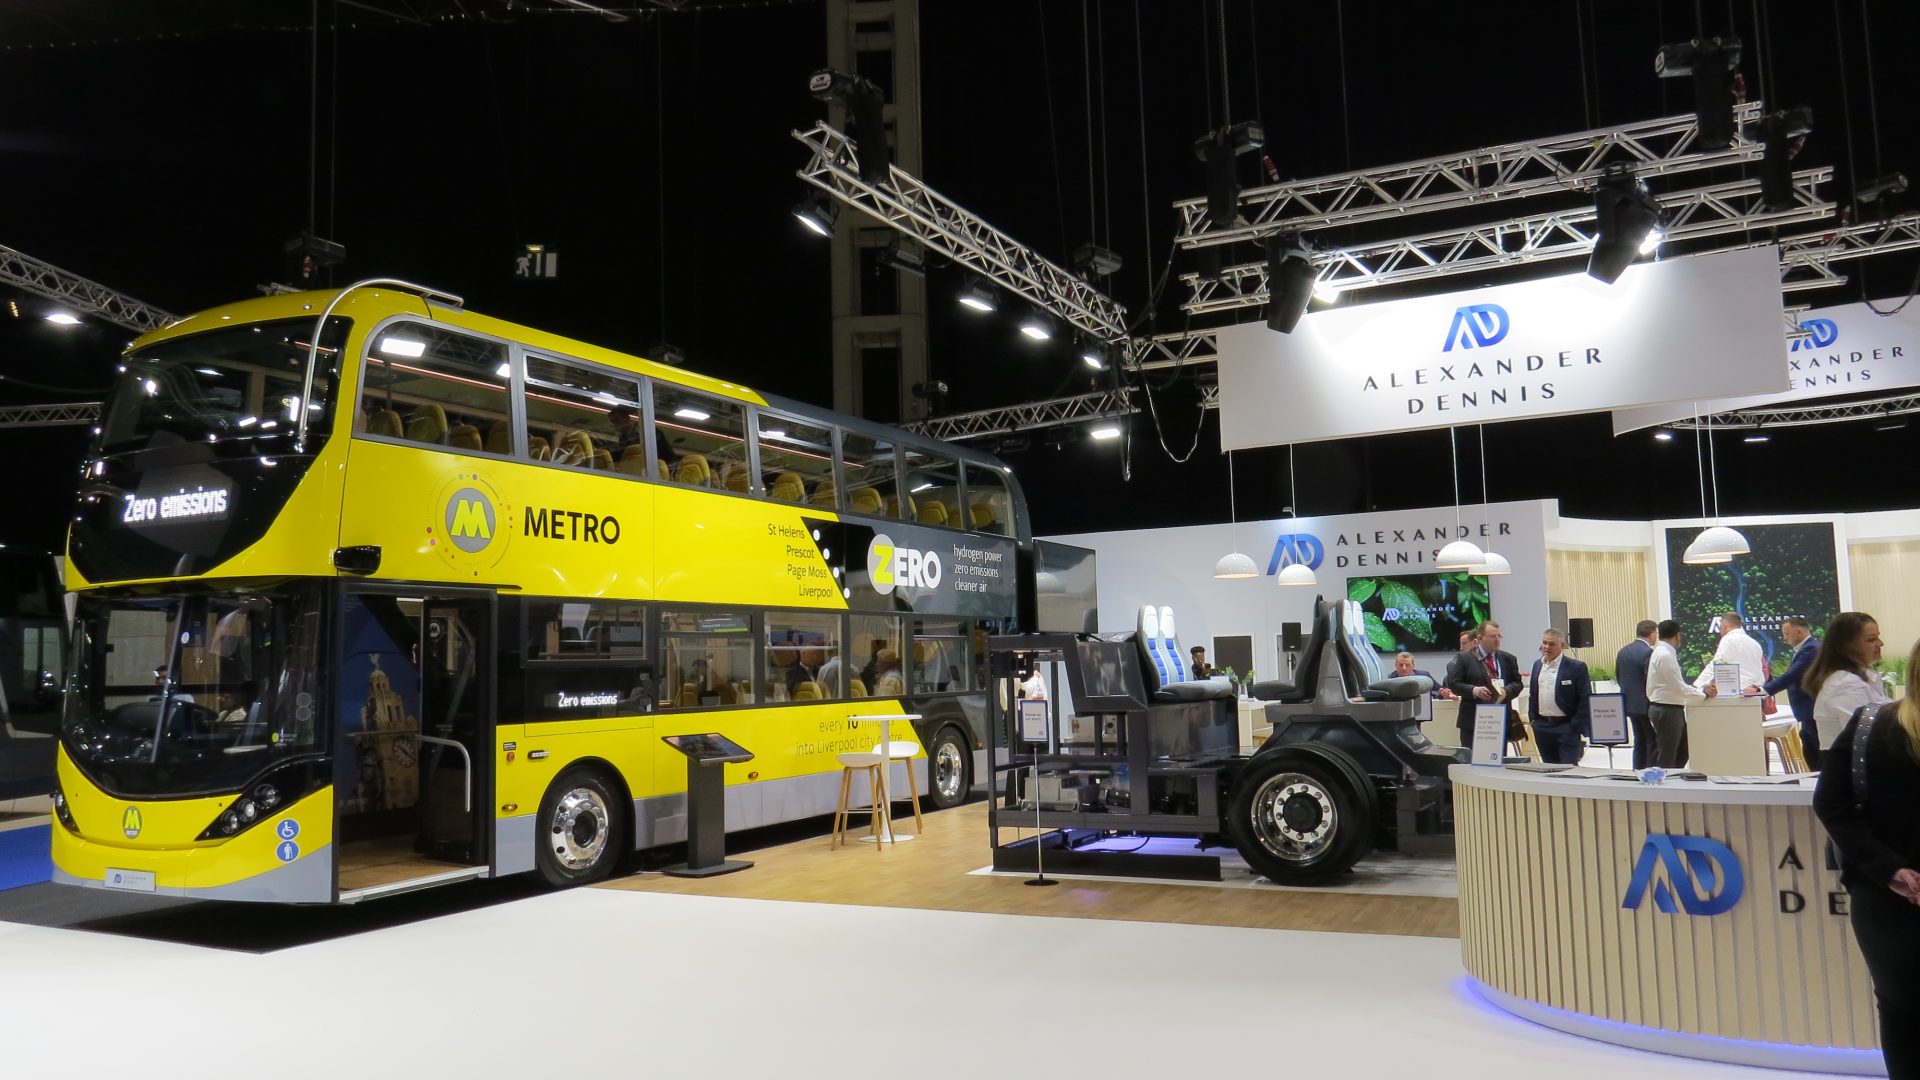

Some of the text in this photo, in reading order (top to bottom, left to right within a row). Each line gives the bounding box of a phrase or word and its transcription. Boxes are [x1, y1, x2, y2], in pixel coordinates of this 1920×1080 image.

[1790, 346, 1904, 371] XANDER
[1363, 348, 1602, 391] ALEXANDER
[1790, 369, 1872, 390] ENNIS
[1407, 382, 1555, 414] DENNIS
[124, 486, 228, 522] Zero emissions
[451, 499, 491, 539] M
[524, 506, 620, 545] METRO
[767, 523, 806, 539] St Helens
[1336, 522, 1512, 546] ALEXANDER
[786, 545, 815, 559] Prescot
[953, 543, 1003, 564] hydrogen power
[787, 564, 828, 580] Page Moss
[872, 544, 942, 589] ZERO
[954, 563, 999, 578] zero emissions
[798, 584, 834, 600] Liverpool
[954, 578, 988, 593] cleaner air
[558, 692, 618, 708] Zero emissions
[819, 720, 843, 734] every
[796, 742, 815, 757] into
[817, 735, 858, 754] Liverpool
[860, 735, 875, 749] city
[124, 809, 140, 829] M
